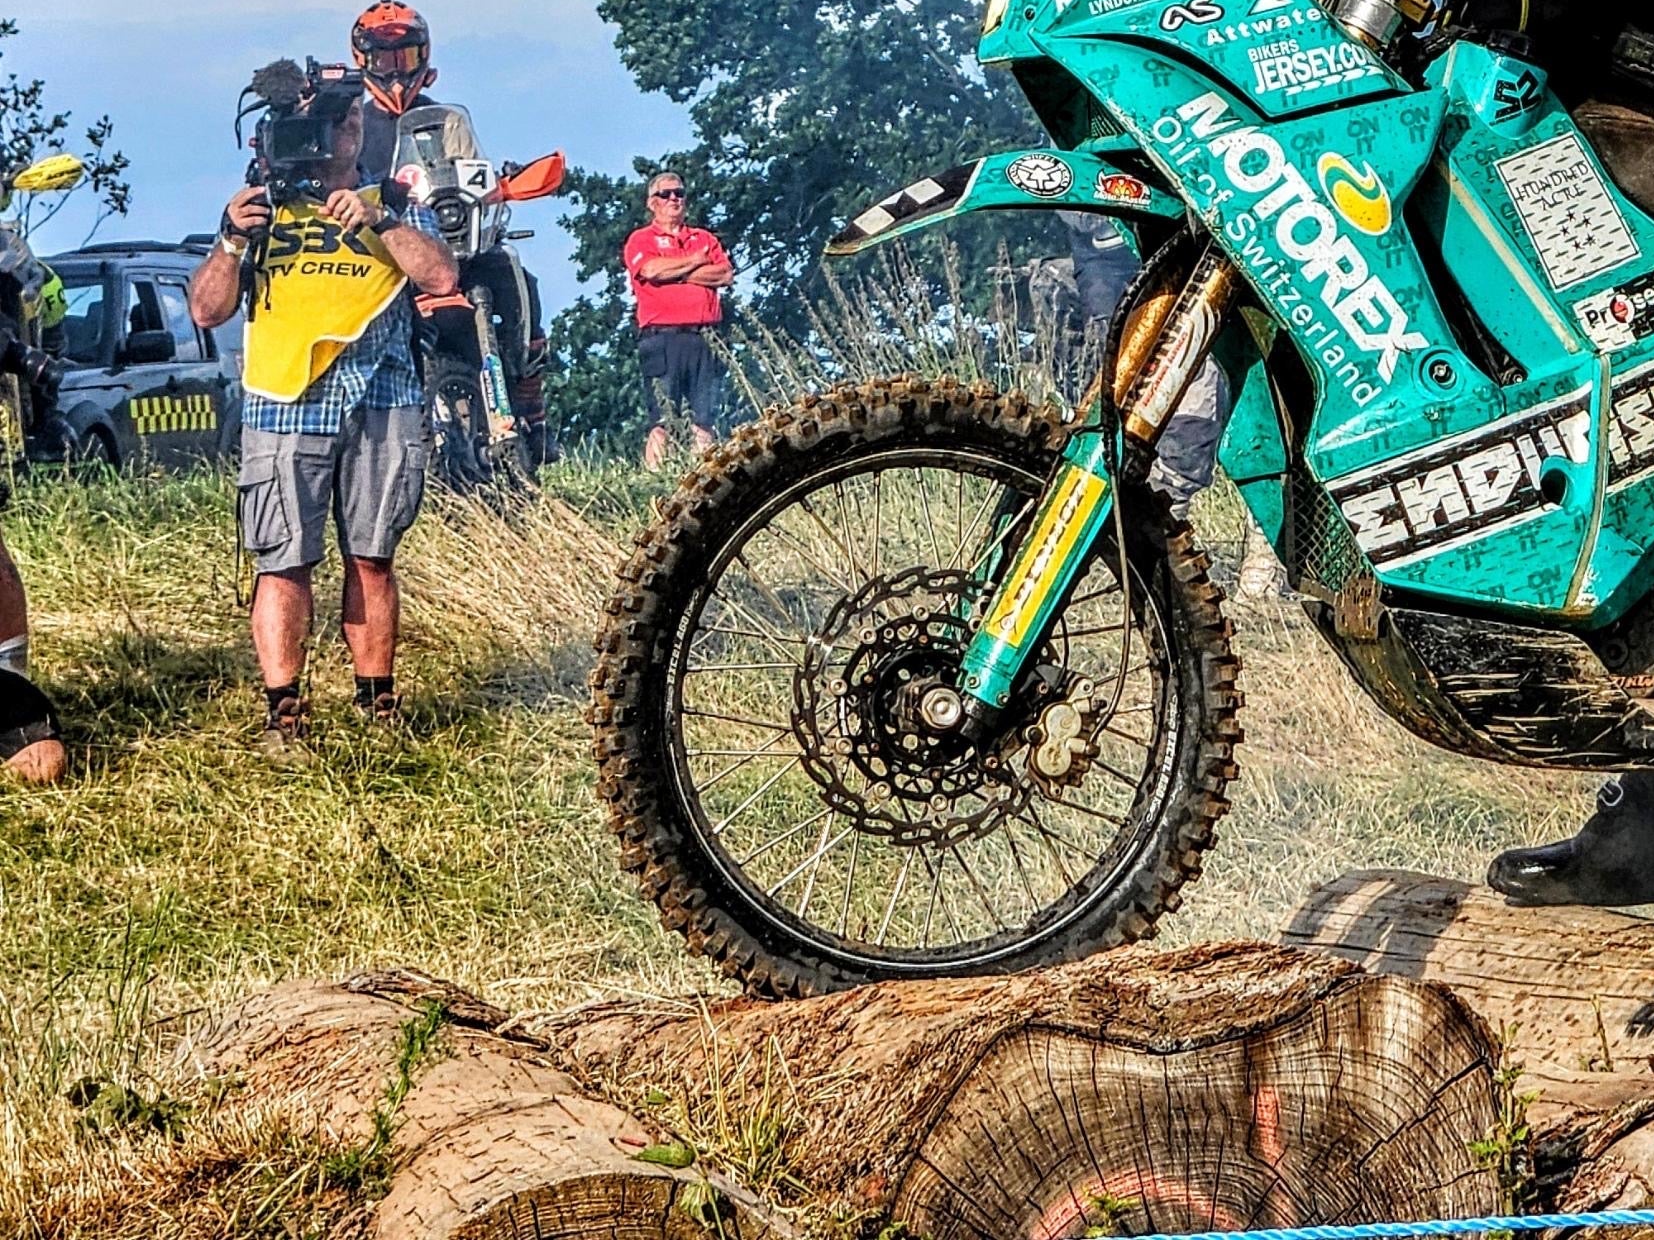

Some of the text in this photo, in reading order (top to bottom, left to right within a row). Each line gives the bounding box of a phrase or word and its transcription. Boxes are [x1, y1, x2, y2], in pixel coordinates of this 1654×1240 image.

[1206, 7, 1327, 47] Attwate
[1248, 39, 1299, 61] BIKERS
[467, 168, 488, 190] 4
[1515, 161, 1590, 202] HUNDRED
[1540, 183, 1583, 212] ACRE
[1177, 92, 1430, 385] MOTOREX
[269, 261, 372, 278] TV CREW
[1152, 116, 1202, 166] Oil
[1226, 212, 1384, 407] Switzerland
